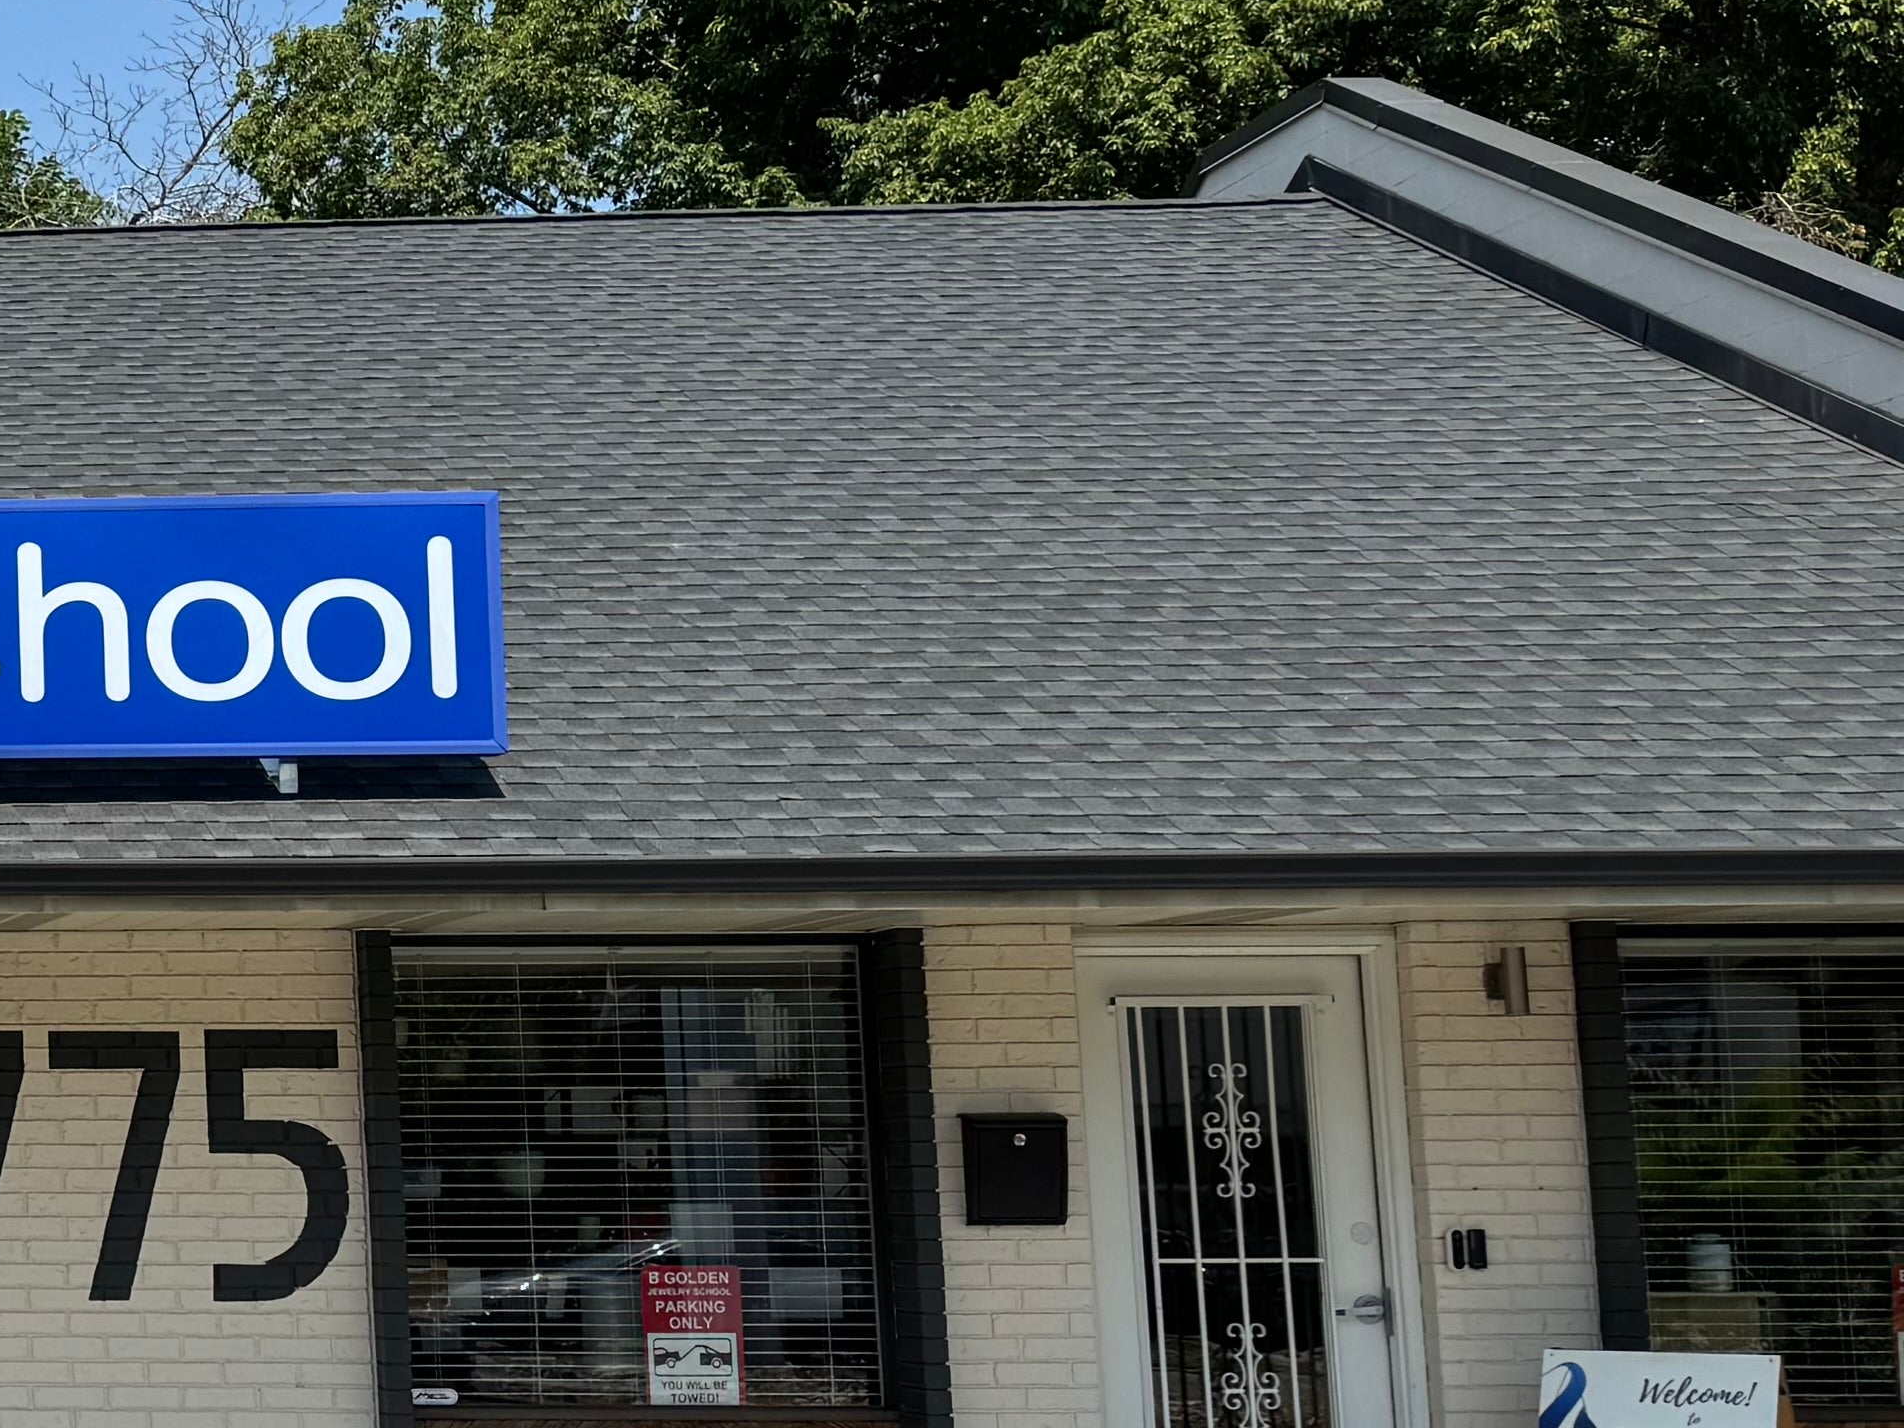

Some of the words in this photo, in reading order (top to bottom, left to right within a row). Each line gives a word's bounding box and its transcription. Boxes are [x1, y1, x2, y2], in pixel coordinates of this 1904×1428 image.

[649, 1272, 659, 1284] B
[664, 1272, 729, 1284] GOLDEN
[655, 1300, 726, 1313] PARKING
[669, 1316, 713, 1330] ONLY
[661, 1381, 683, 1390] YOU
[686, 1381, 711, 1390] WILL
[713, 1381, 728, 1390] BE
[1639, 1375, 1758, 1407] Welcome!
[670, 1393, 719, 1404] TOWED!
[1686, 1412, 1701, 1426] to
